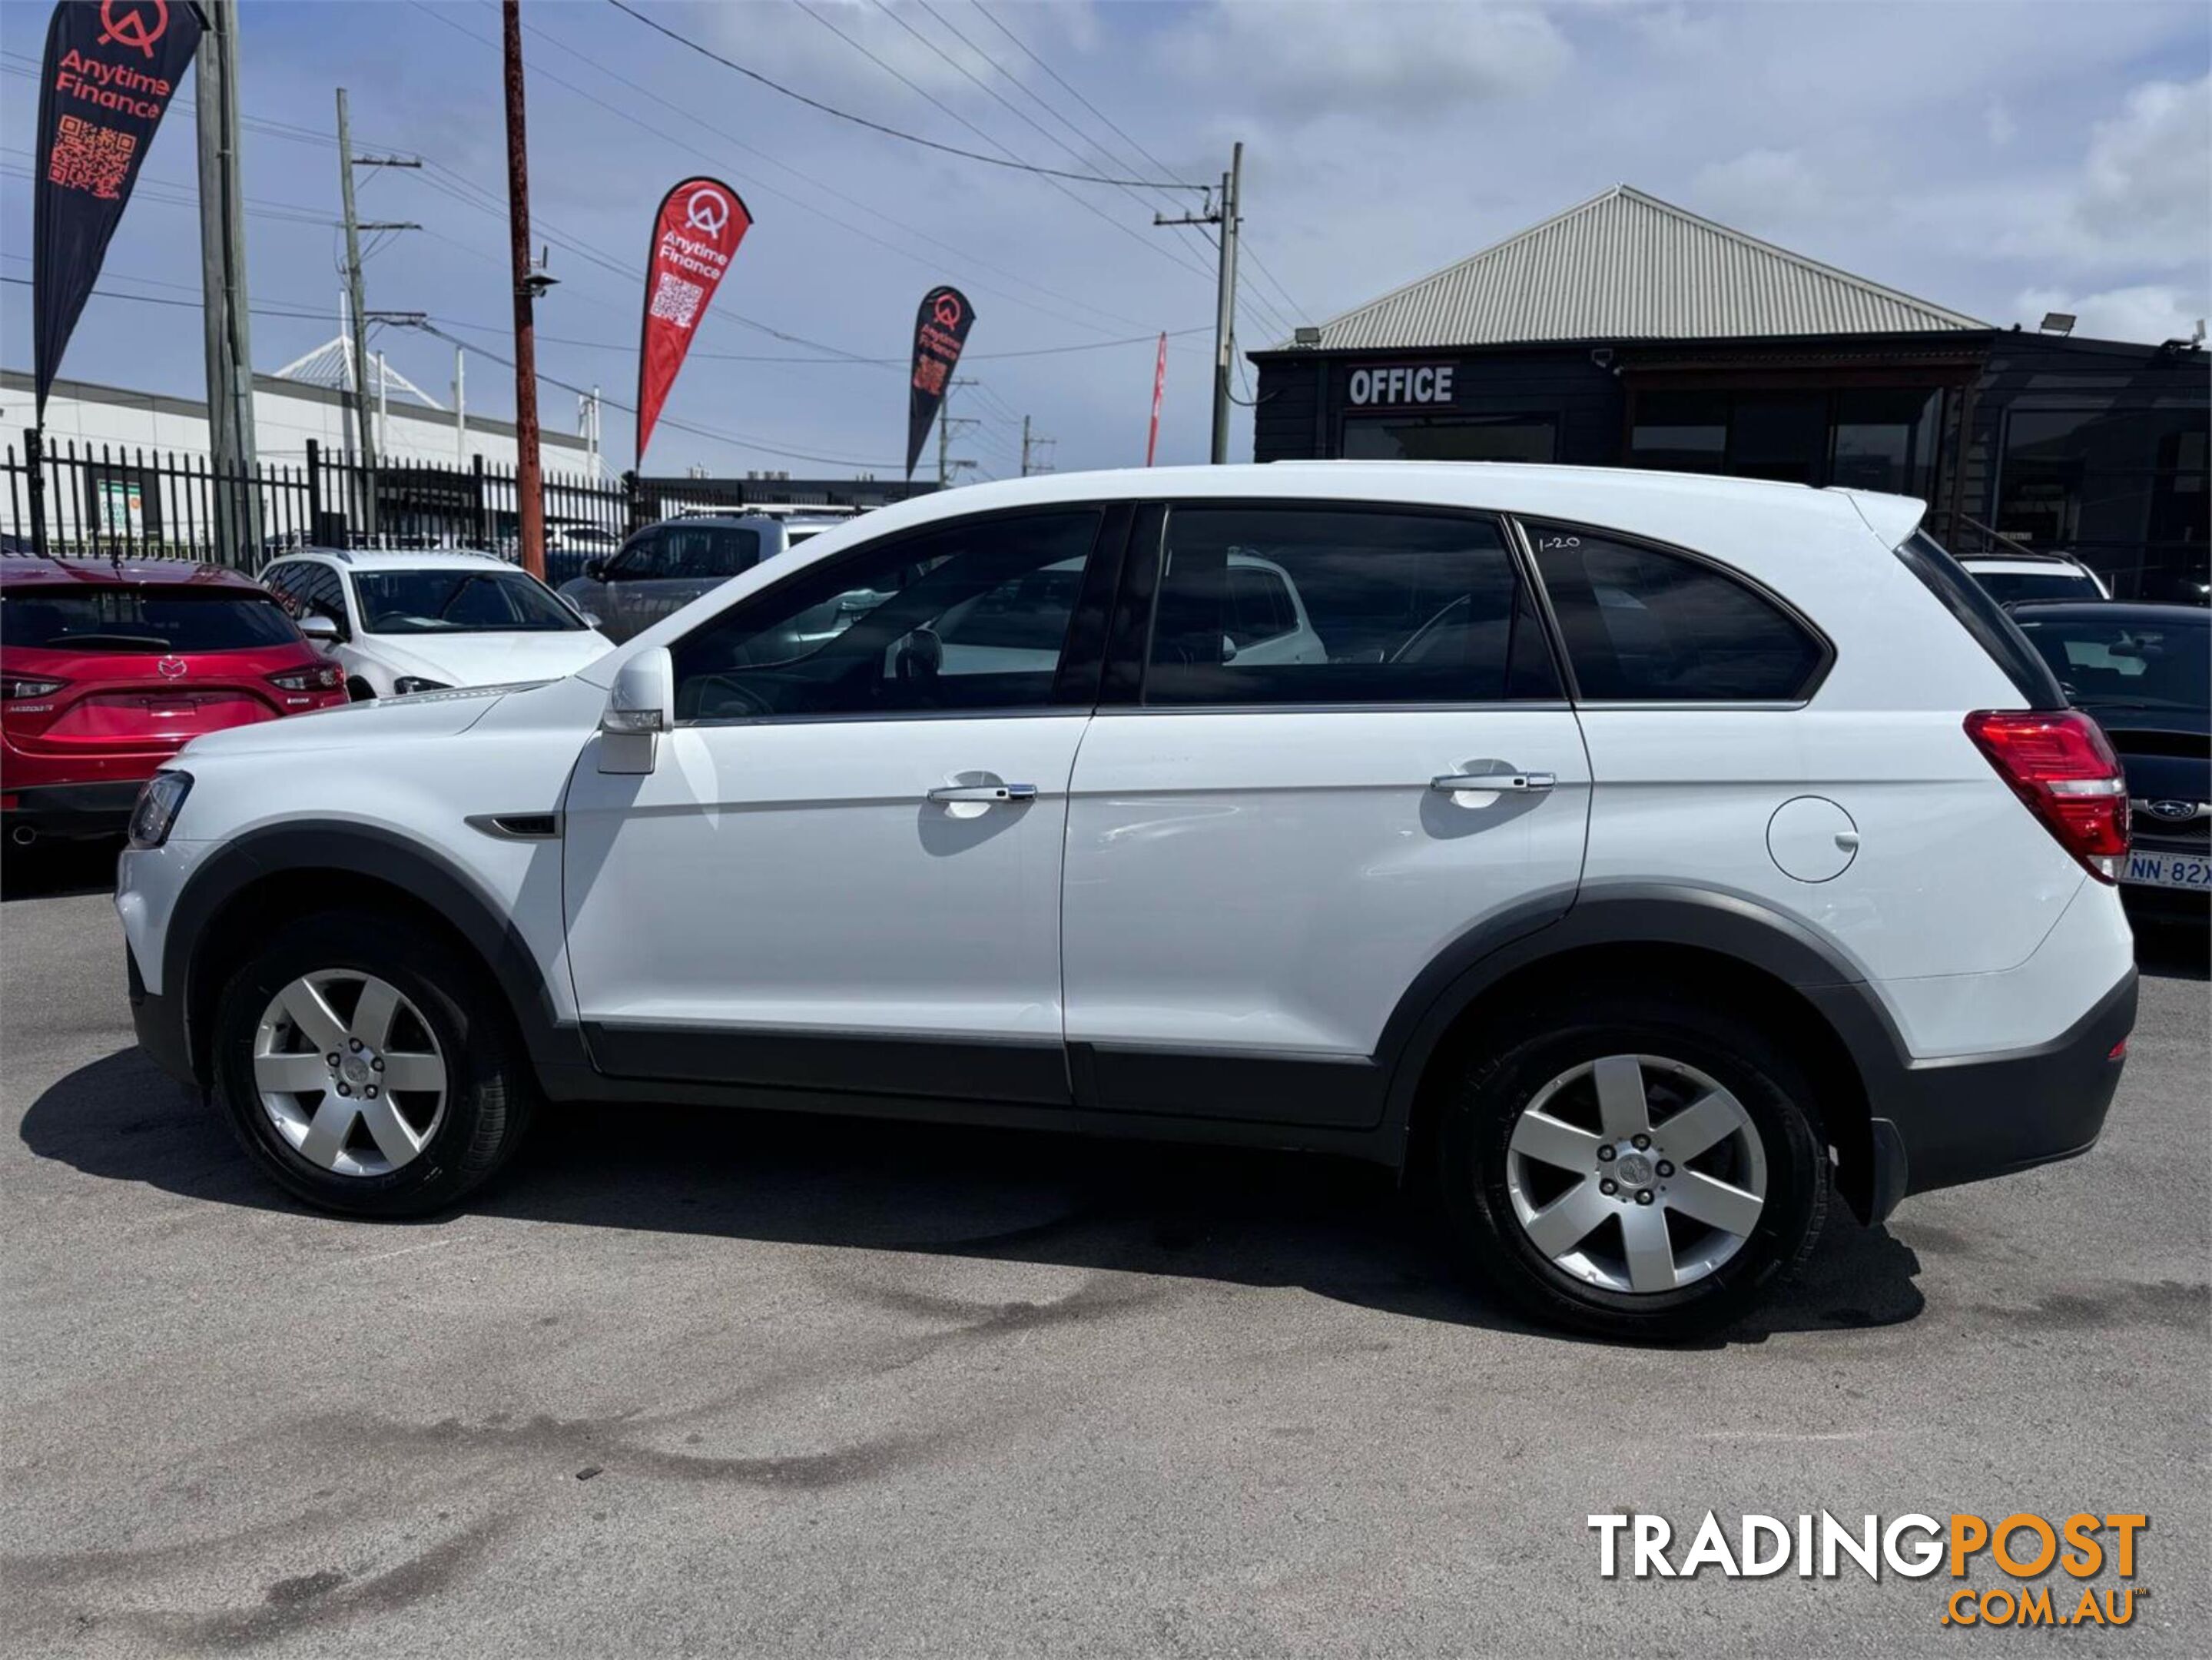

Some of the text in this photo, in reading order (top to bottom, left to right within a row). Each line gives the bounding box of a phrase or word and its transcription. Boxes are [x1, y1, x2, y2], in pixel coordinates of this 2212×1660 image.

[60, 48, 171, 96] Anytime
[56, 73, 161, 119] Finance
[659, 246, 721, 280] Finance
[662, 231, 728, 266] Anytime
[1349, 367, 1454, 405] OFFICE
[1539, 537, 1580, 553] 1-20
